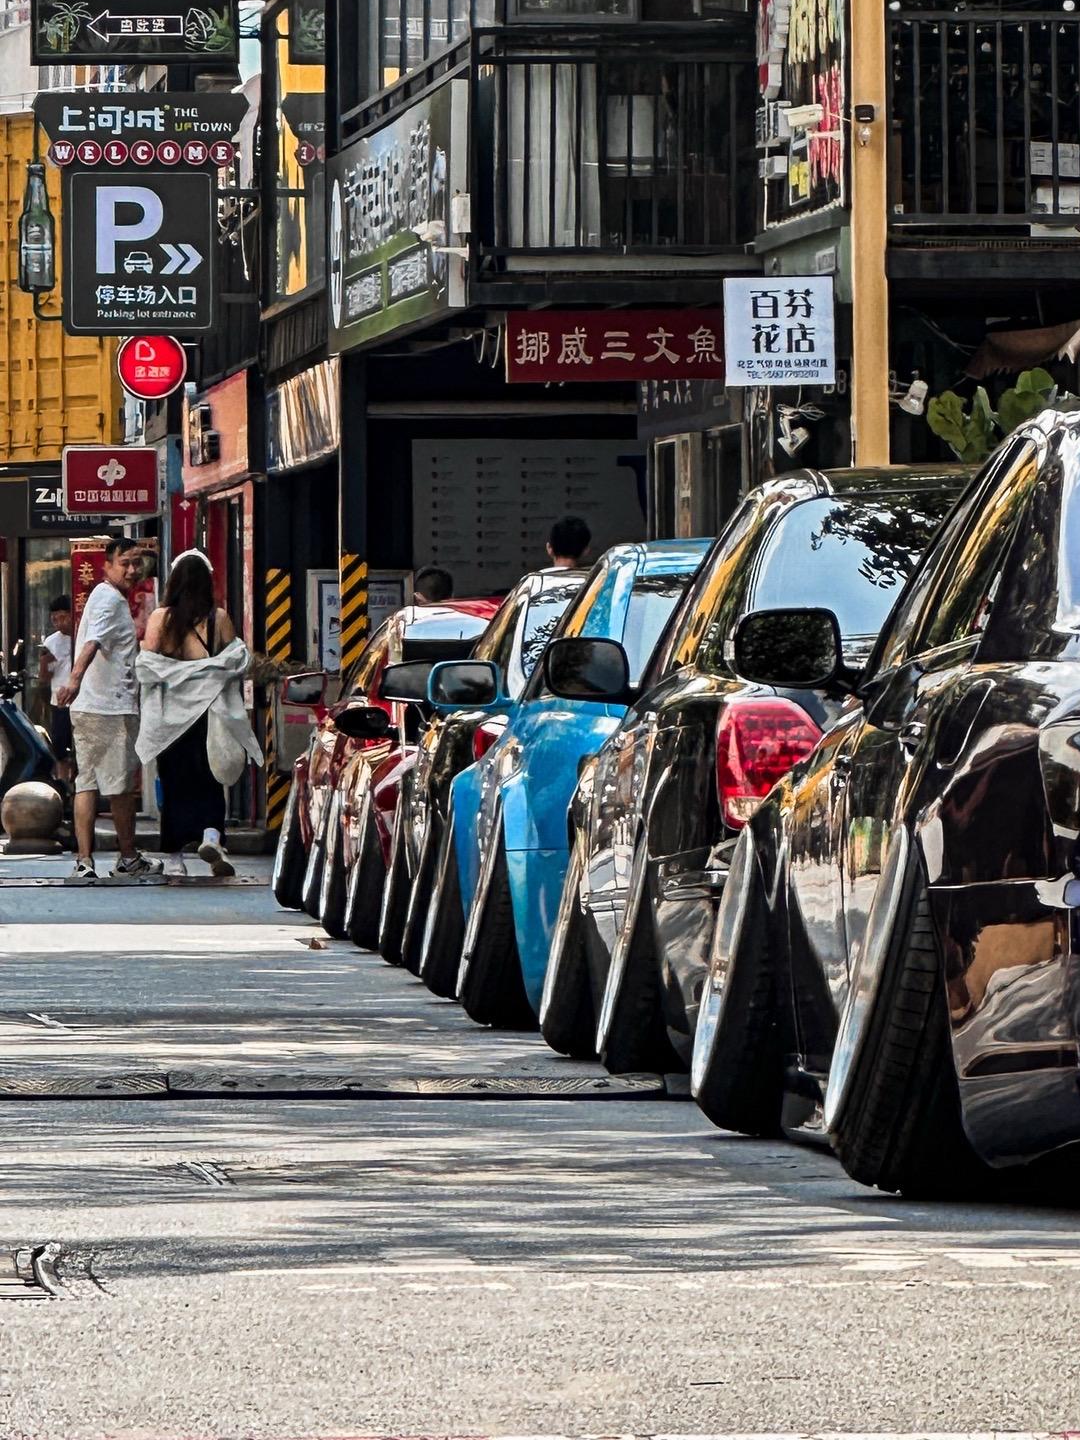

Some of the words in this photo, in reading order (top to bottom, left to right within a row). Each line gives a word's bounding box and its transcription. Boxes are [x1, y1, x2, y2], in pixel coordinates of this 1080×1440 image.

[174, 107, 199, 118] THE
[174, 122, 232, 132] UPTOWN
[53, 145, 229, 162] WELCOME
[96, 186, 163, 274] P
[95, 285, 197, 304] 停车场入口
[750, 288, 815, 318] 百芬
[97, 309, 135, 320] Parking
[137, 309, 150, 318] lot
[152, 310, 197, 318] entrance
[751, 323, 816, 354] 花店
